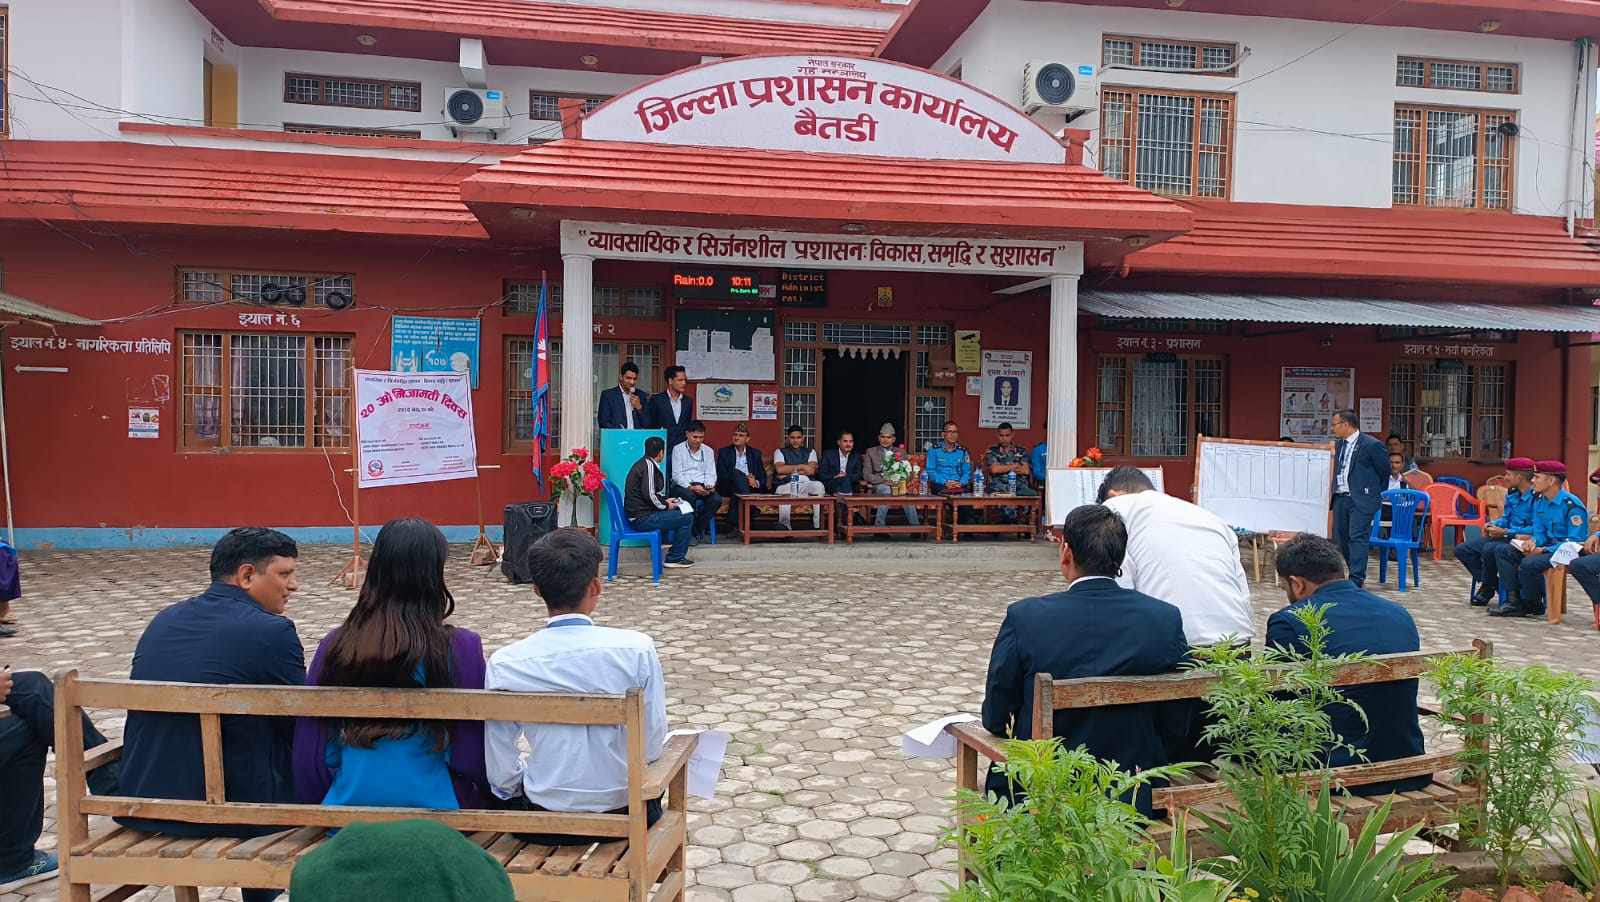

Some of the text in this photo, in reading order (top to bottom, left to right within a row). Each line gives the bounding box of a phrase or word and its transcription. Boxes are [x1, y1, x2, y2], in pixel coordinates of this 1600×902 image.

[634, 76, 1019, 153] जिल्ला प्रशासन कार्यालय
[794, 107, 879, 142] बैतडी
[683, 236, 694, 255] र
[697, 233, 787, 258] सिर्जनशील
[975, 244, 988, 265] र
[674, 274, 714, 287] Rain:0.0
[731, 276, 752, 286] 10:11
[782, 273, 824, 282] District
[291, 313, 301, 328] ६
[76, 336, 133, 354] नागरिकता
[135, 337, 172, 355] प्रतिलिपि
[1166, 338, 1201, 350] प्रशासन
[361, 404, 375, 418] २०
[392, 388, 440, 401] निजामती
[441, 393, 468, 419] दिवस
